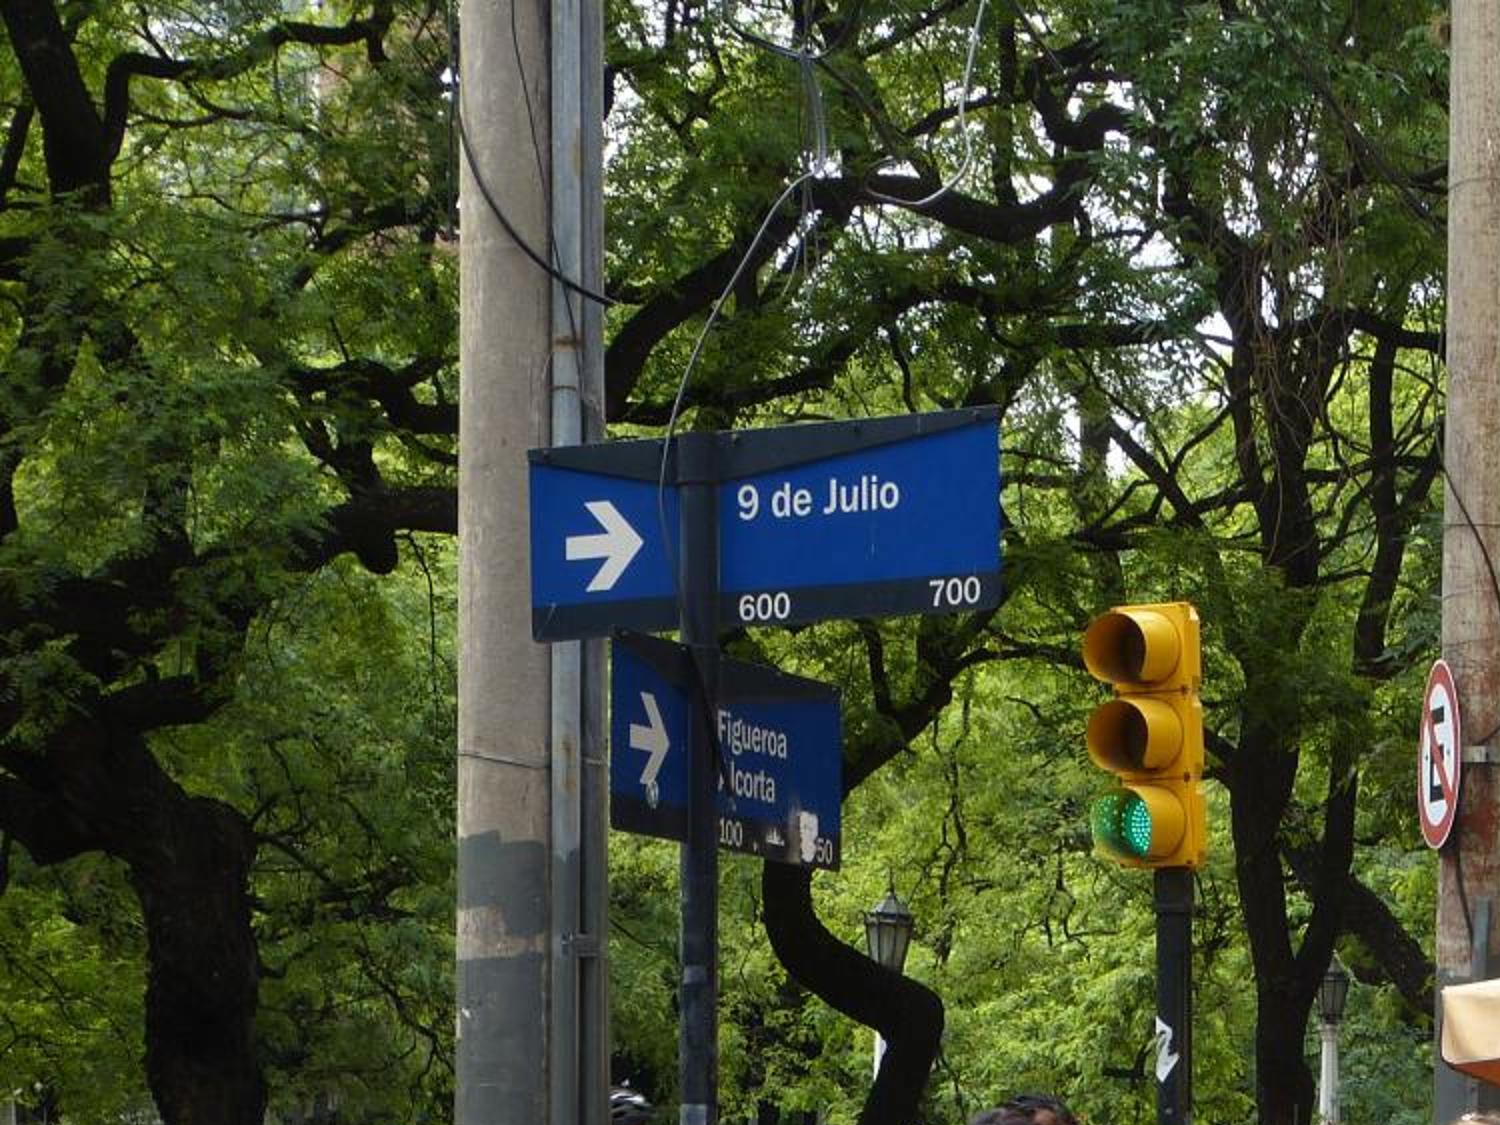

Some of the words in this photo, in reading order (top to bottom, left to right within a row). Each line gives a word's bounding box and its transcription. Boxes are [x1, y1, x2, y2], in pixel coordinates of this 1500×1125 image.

[738, 483, 759, 521] 9
[772, 482, 812, 517] de
[823, 474, 900, 516] Julio
[739, 591, 791, 621] 600
[929, 576, 981, 608] 700
[717, 709, 787, 760] Figueroa
[719, 817, 743, 848] 100
